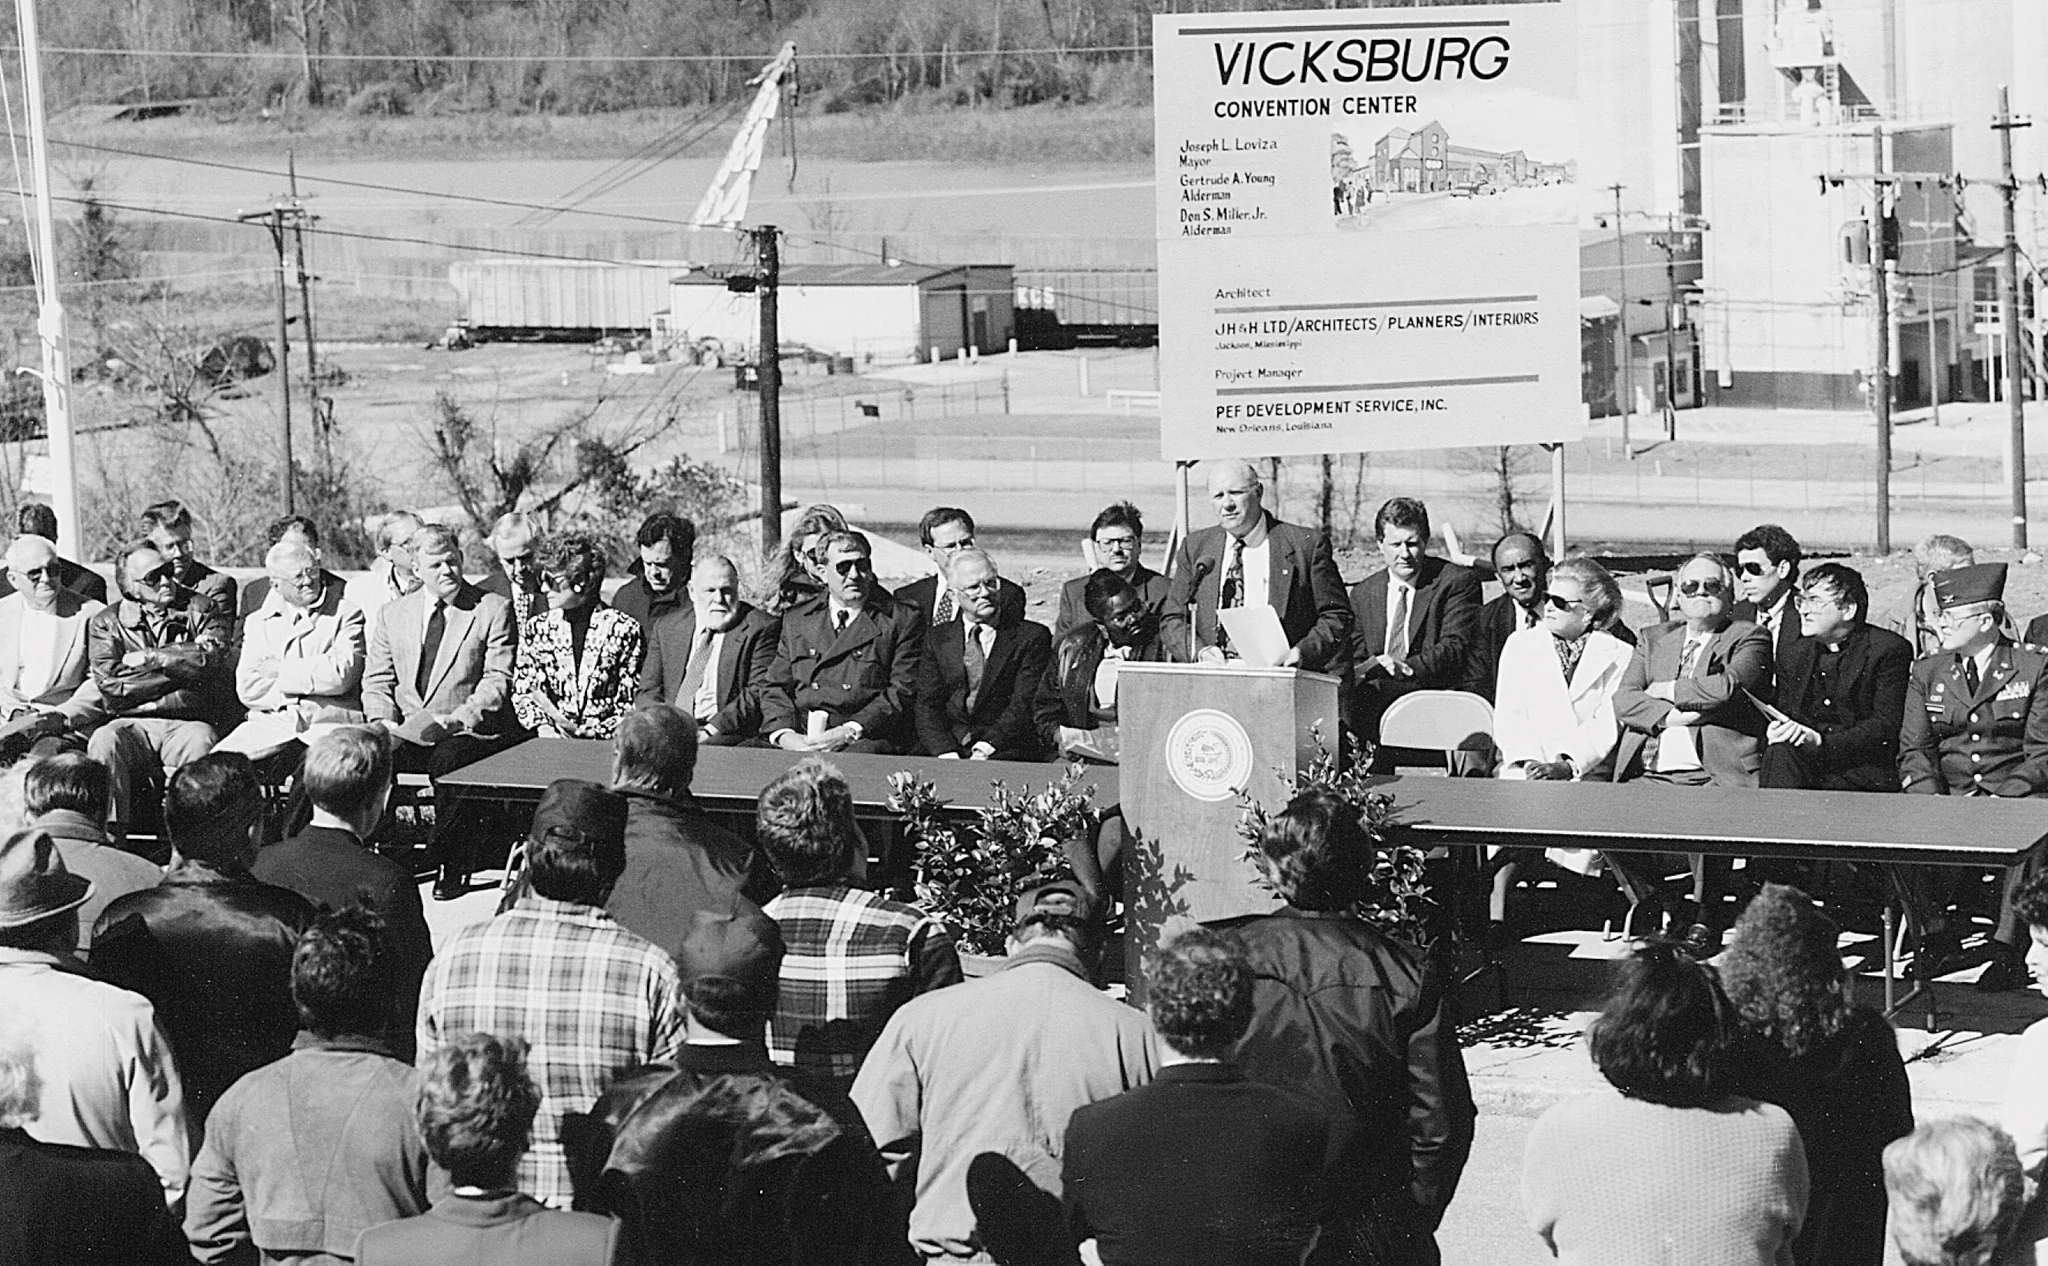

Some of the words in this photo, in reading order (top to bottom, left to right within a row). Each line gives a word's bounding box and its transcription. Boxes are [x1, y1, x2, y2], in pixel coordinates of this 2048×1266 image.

[1214, 36, 1510, 86] VICKSBURG
[1214, 98, 1331, 118] CONVENTION
[1342, 95, 1417, 114] CENTER
[1180, 139, 1218, 153] Joseph
[1235, 137, 1277, 151] Loviza
[1179, 154, 1211, 170] Mayor
[1180, 173, 1230, 187] Gertrude
[1244, 172, 1275, 187] Young
[1182, 189, 1231, 202] Alderman
[1180, 208, 1201, 222] Don
[1182, 224, 1232, 237] Alderman
[1018, 286, 1055, 305] KCS
[1214, 288, 1271, 300] Architect
[1215, 369, 1253, 383] Project
[1257, 368, 1303, 380] Manager
[1216, 405, 1242, 418] PEF
[1246, 401, 1352, 418] DEVELOPMENT
[1216, 425, 1236, 434] New
[1285, 421, 1333, 432] Louisiana
